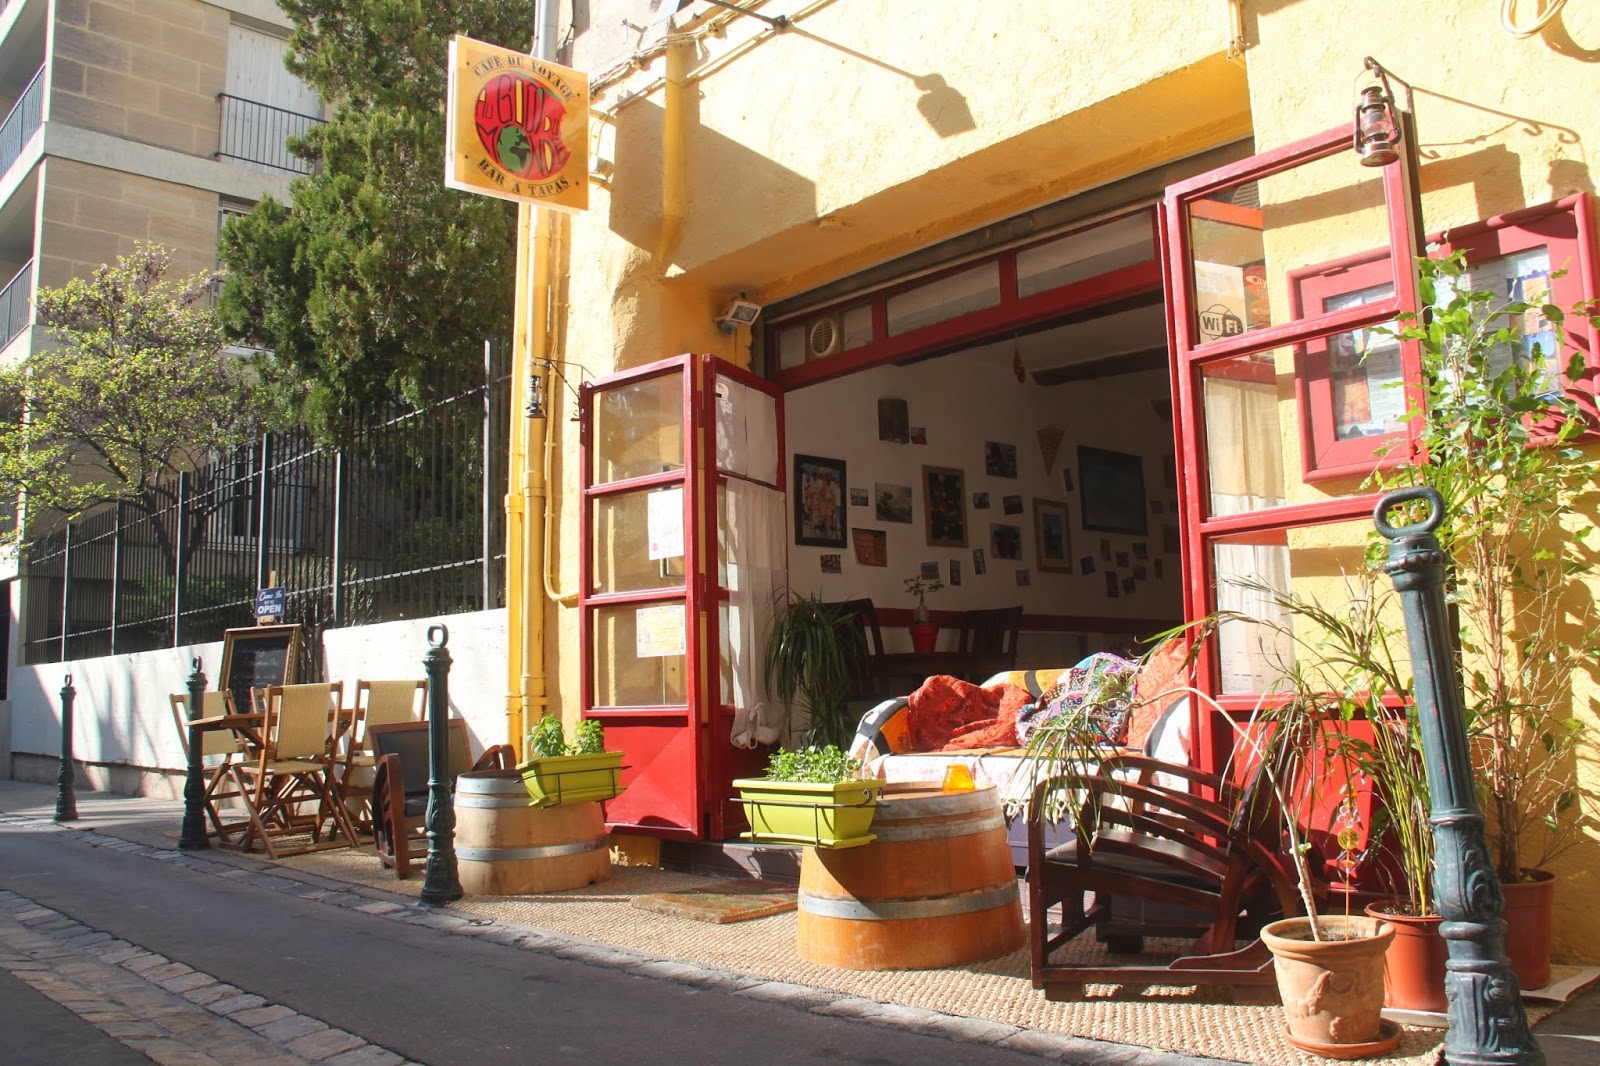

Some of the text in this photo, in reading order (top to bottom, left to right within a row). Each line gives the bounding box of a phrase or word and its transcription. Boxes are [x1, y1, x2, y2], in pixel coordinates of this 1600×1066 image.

[508, 55, 524, 67] DU
[531, 61, 575, 101] VOYAGE
[478, 158, 505, 186] BAR
[528, 176, 570, 196] TAPAS
[257, 604, 282, 614] OPEN
